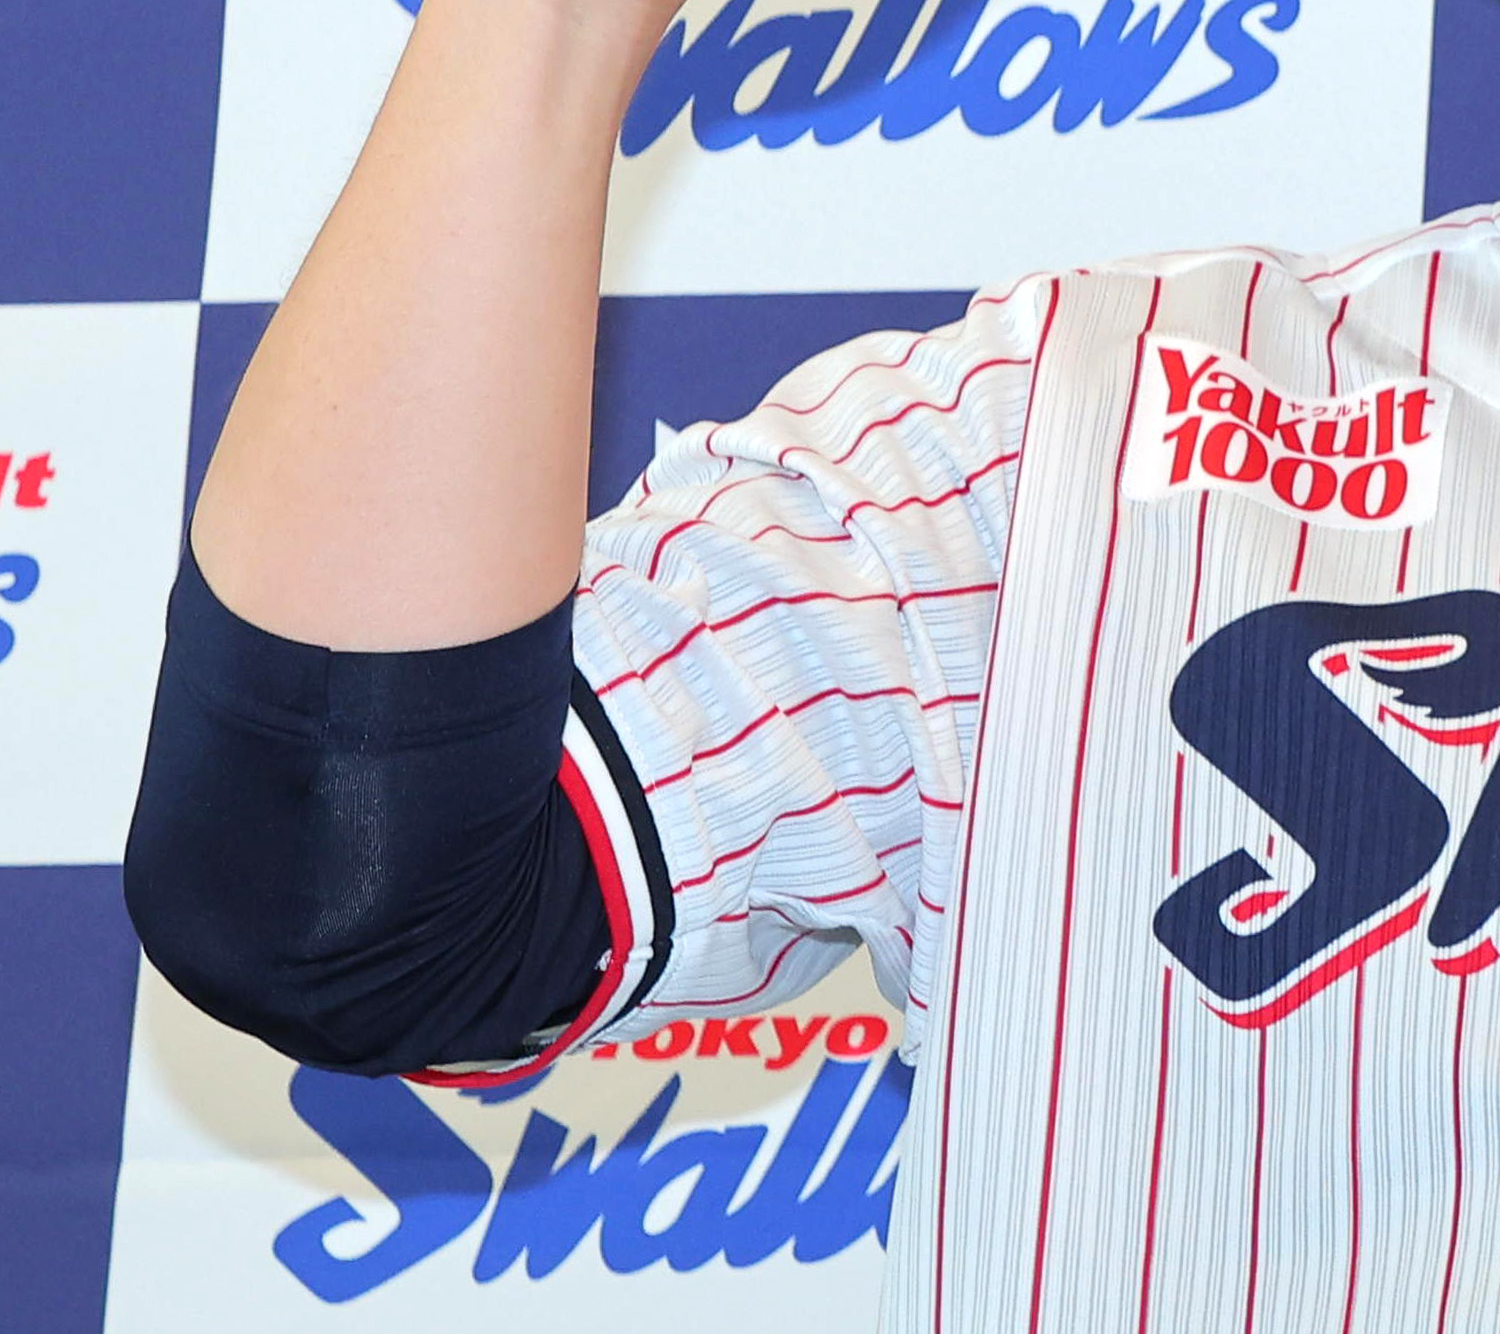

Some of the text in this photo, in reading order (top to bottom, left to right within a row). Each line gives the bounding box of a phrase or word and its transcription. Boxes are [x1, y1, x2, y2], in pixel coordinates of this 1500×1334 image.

[1157, 345, 1436, 459] Yakult
[1287, 398, 1370, 418] ヤクルト
[1162, 415, 1409, 520] 1000
[592, 1014, 890, 1072] okyo
